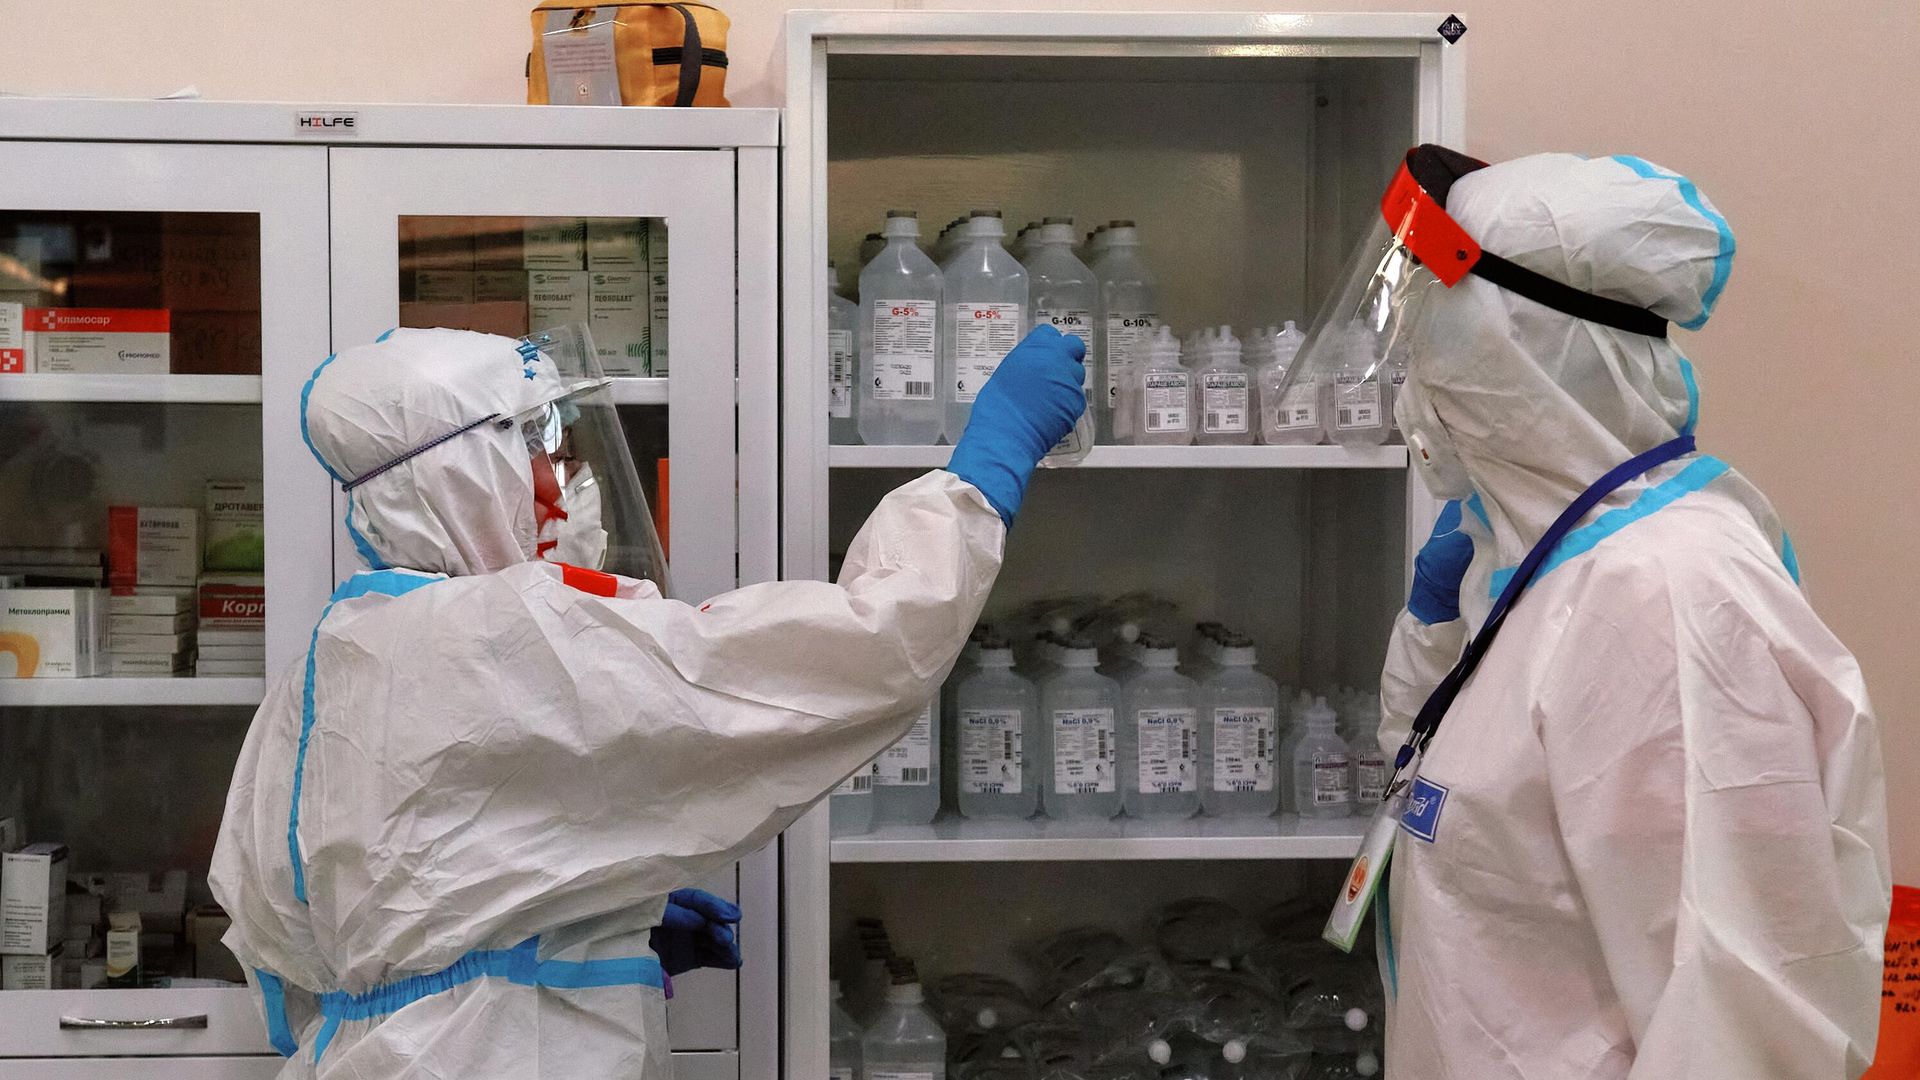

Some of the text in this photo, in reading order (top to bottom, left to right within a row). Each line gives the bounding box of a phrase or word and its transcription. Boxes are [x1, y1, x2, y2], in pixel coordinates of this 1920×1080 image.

[300, 117, 354, 127] HILFE
[892, 307, 919, 317] G-5%
[974, 310, 1002, 319] G-5%
[57, 316, 111, 326] кламосар
[1052, 317, 1082, 325] G-10%
[1123, 319, 1152, 327] G-10%
[8, 607, 70, 616] Метоклопрамид
